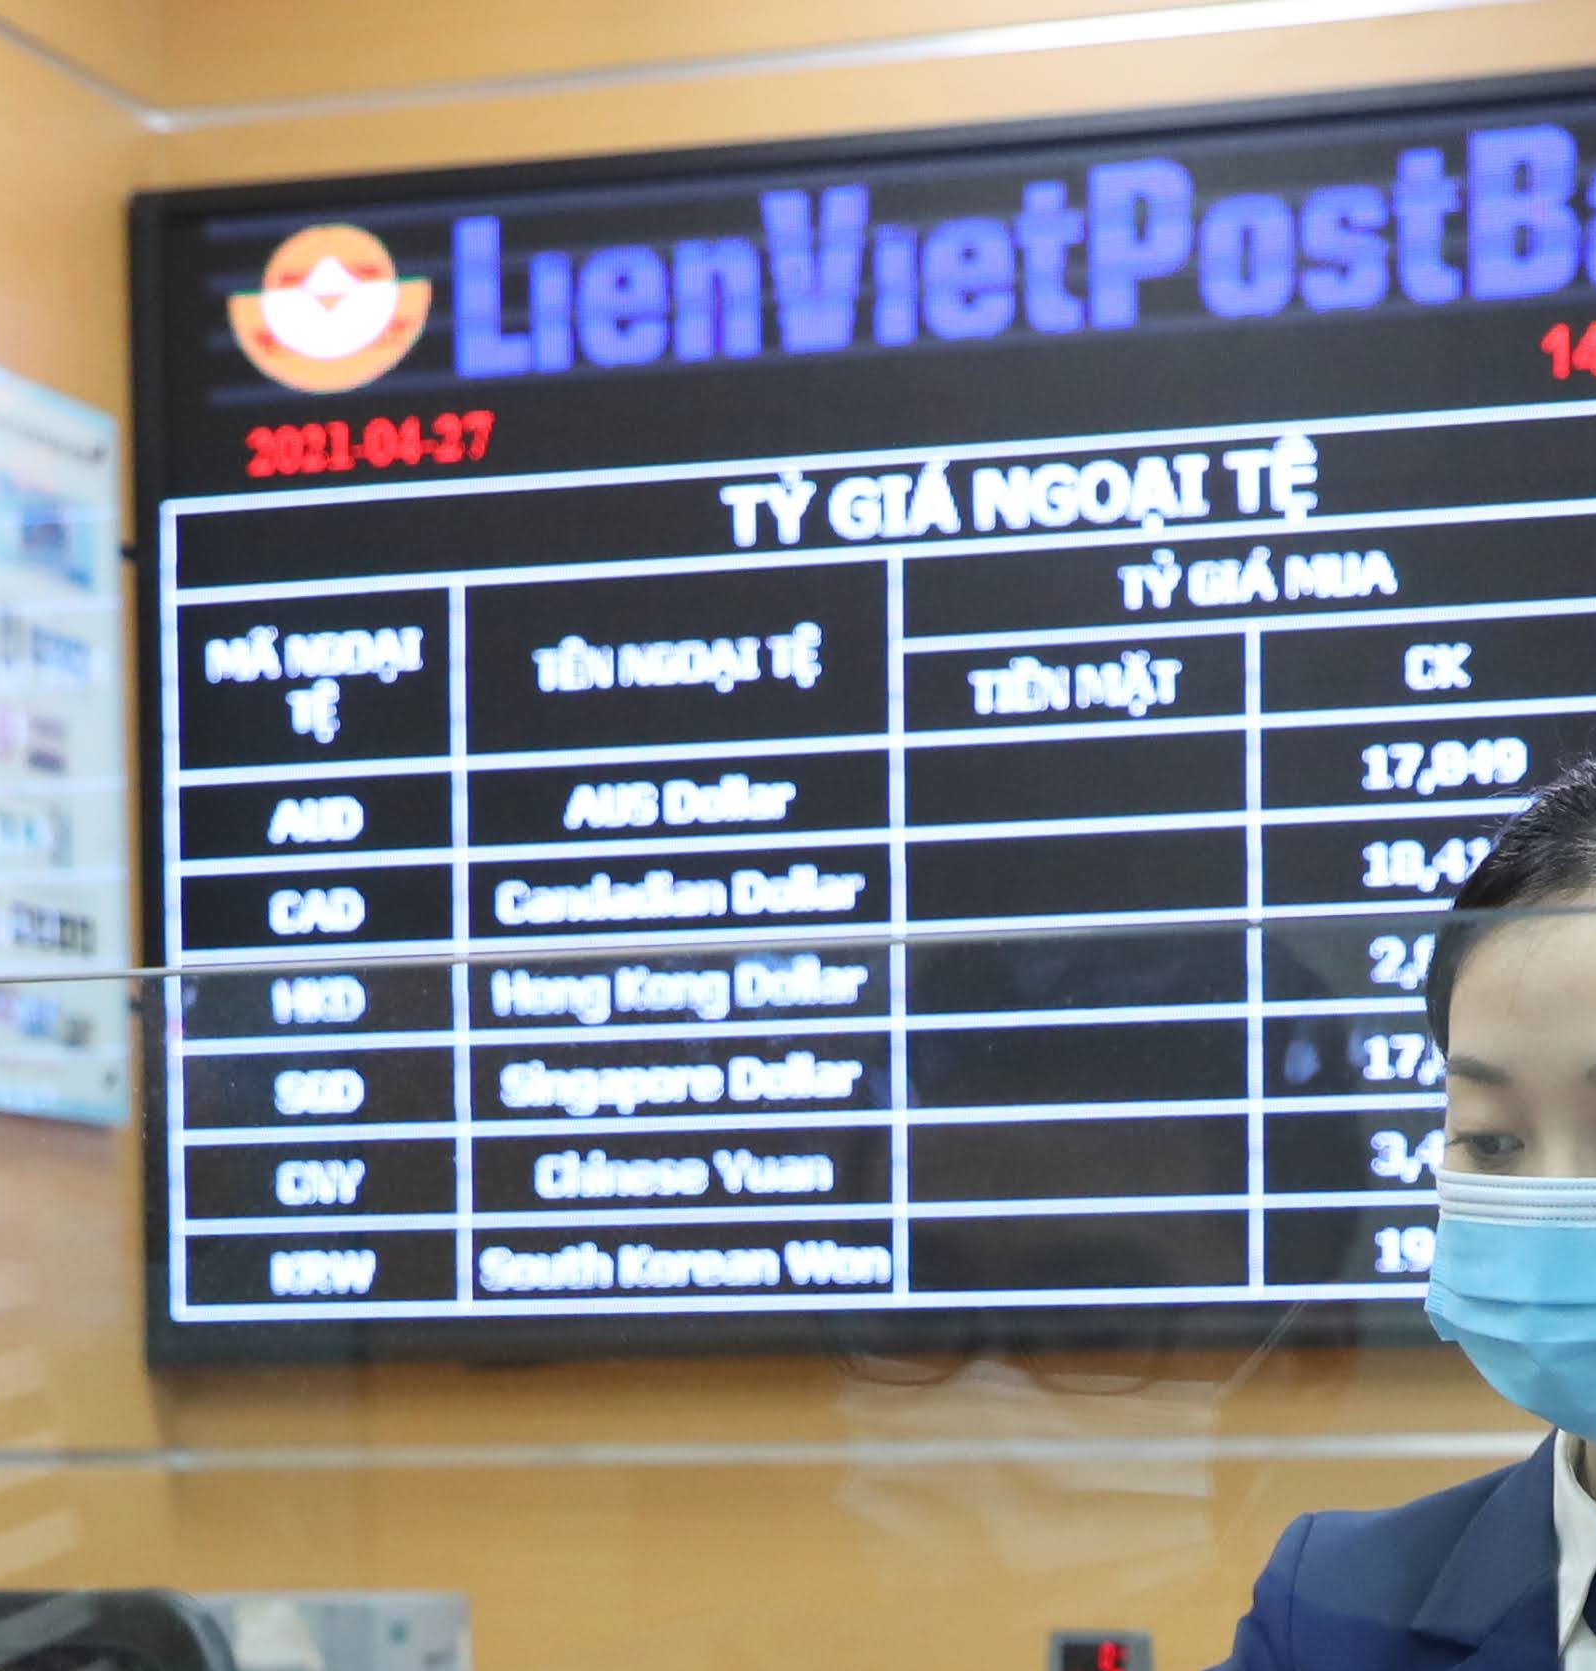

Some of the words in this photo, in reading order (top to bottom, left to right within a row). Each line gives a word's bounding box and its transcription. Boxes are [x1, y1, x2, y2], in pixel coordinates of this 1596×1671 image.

[245, 409, 496, 478] 2021-04-27
[720, 465, 816, 547] TỶ
[828, 459, 961, 539] GIÁ
[972, 452, 1211, 534] NGOẠI
[1223, 434, 1319, 522] TỆ
[1282, 550, 1398, 600] MUA
[1404, 643, 1471, 691] CK
[1361, 736, 1529, 796] 17,849
[266, 794, 365, 845] AUD
[661, 773, 796, 825] Dollar
[269, 887, 365, 935] CAD
[730, 864, 865, 915] Dollar
[491, 969, 611, 1024] Hong
[614, 965, 730, 1020] Kong
[733, 954, 868, 1008] Dollar
[500, 1060, 725, 1118] Singapore
[727, 1050, 864, 1102] Dollar
[534, 1149, 709, 1199] Chinese
[713, 1149, 833, 1194] Yuan
[479, 1242, 614, 1292] South
[616, 1242, 781, 1289] Korean
[784, 1239, 891, 1287] Won
